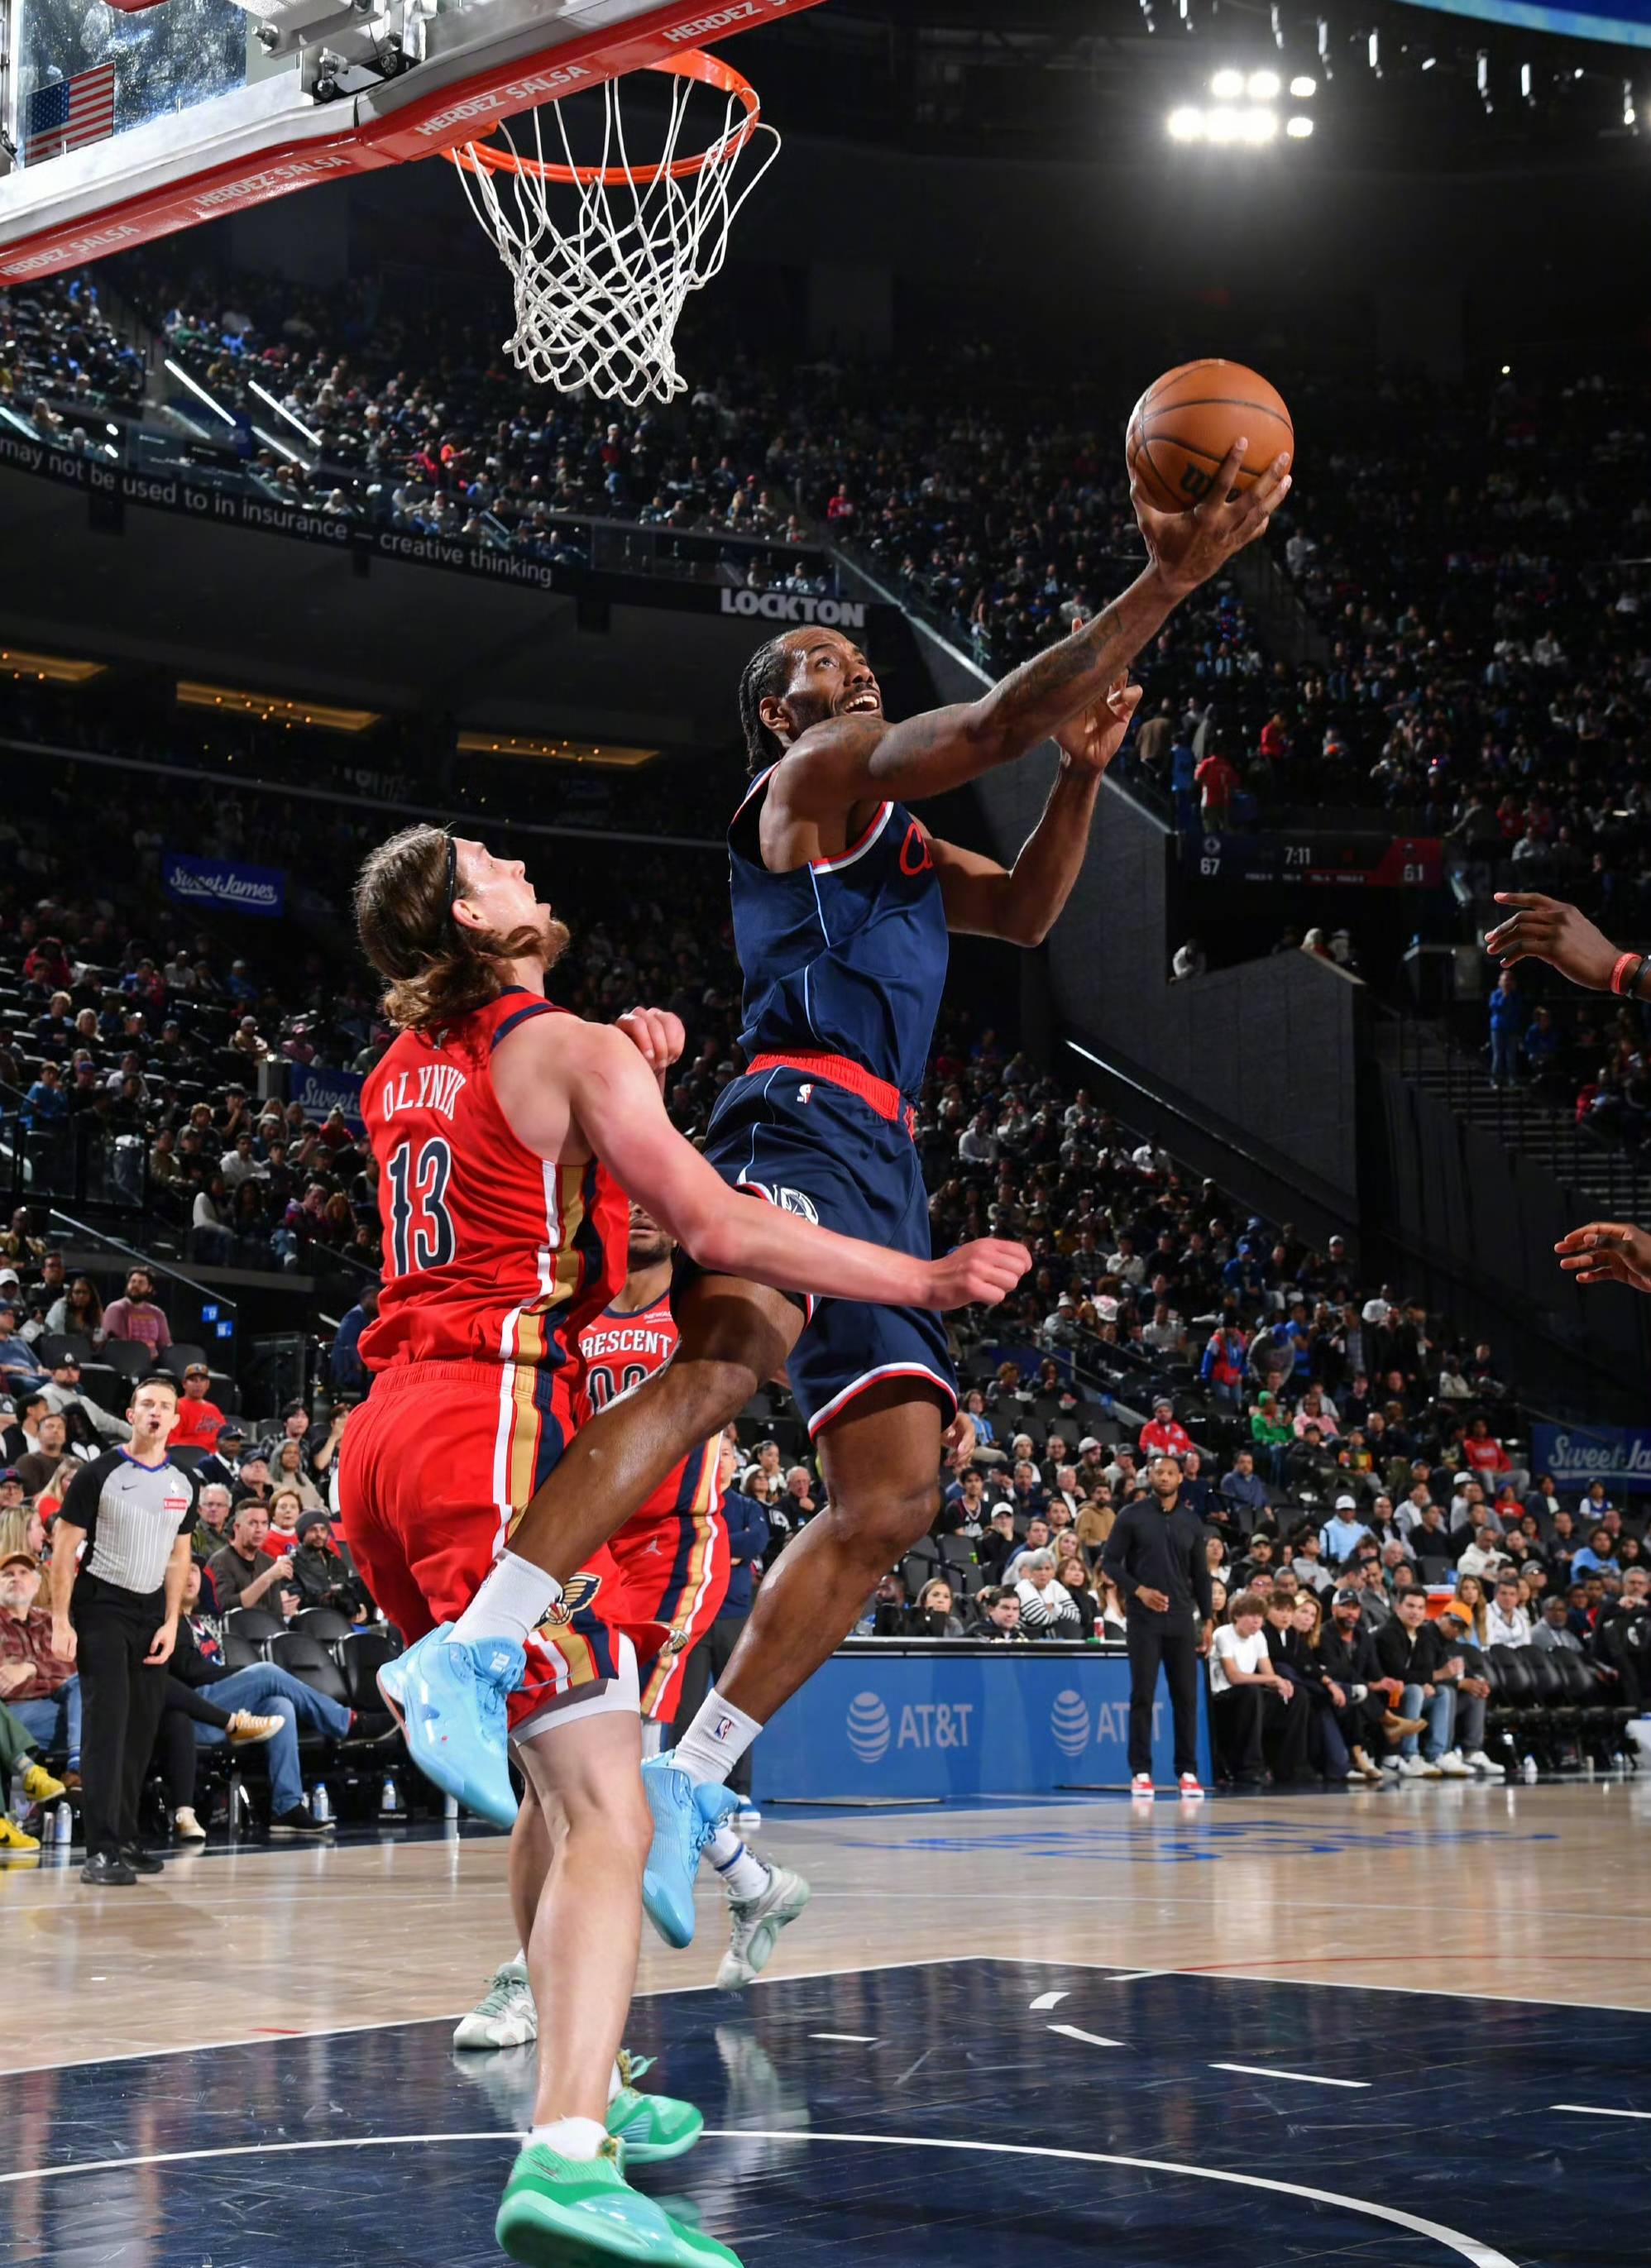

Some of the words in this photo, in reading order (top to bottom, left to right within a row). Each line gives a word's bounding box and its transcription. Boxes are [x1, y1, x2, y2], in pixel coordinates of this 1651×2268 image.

[662, 2, 763, 42] HERDEZ
[415, 94, 505, 136] HERDEZ
[505, 65, 591, 99] SALSA
[194, 175, 274, 207] HERDEZ
[275, 156, 352, 179] SALSA
[0, 247, 72, 276] HERDEZ
[69, 225, 141, 252] SALSA
[0, 438, 43, 471] may
[49, 452, 84, 481] not
[90, 462, 116, 490] be
[123, 476, 176, 505] used
[184, 486, 207, 510] to
[214, 492, 235, 518] in
[242, 498, 348, 539] insurance
[380, 533, 464, 565] creative
[470, 548, 553, 589] thinking
[720, 587, 865, 629] LOCKTON
[1199, 856, 1221, 876] 67
[1284, 846, 1311, 865] 7:11
[1403, 864, 1424, 883] 61
[170, 868, 222, 892] Sweet
[219, 873, 275, 900] James
[299, 1076, 356, 1114] Sweet
[383, 1064, 467, 1122] OLYNYK
[387, 1136, 455, 1278] 13
[579, 1329, 672, 1359] RESCENT
[1548, 1433, 1624, 1470] Sweet
[897, 1704, 973, 1749] AT&T
[1096, 1701, 1164, 1744] ATT
